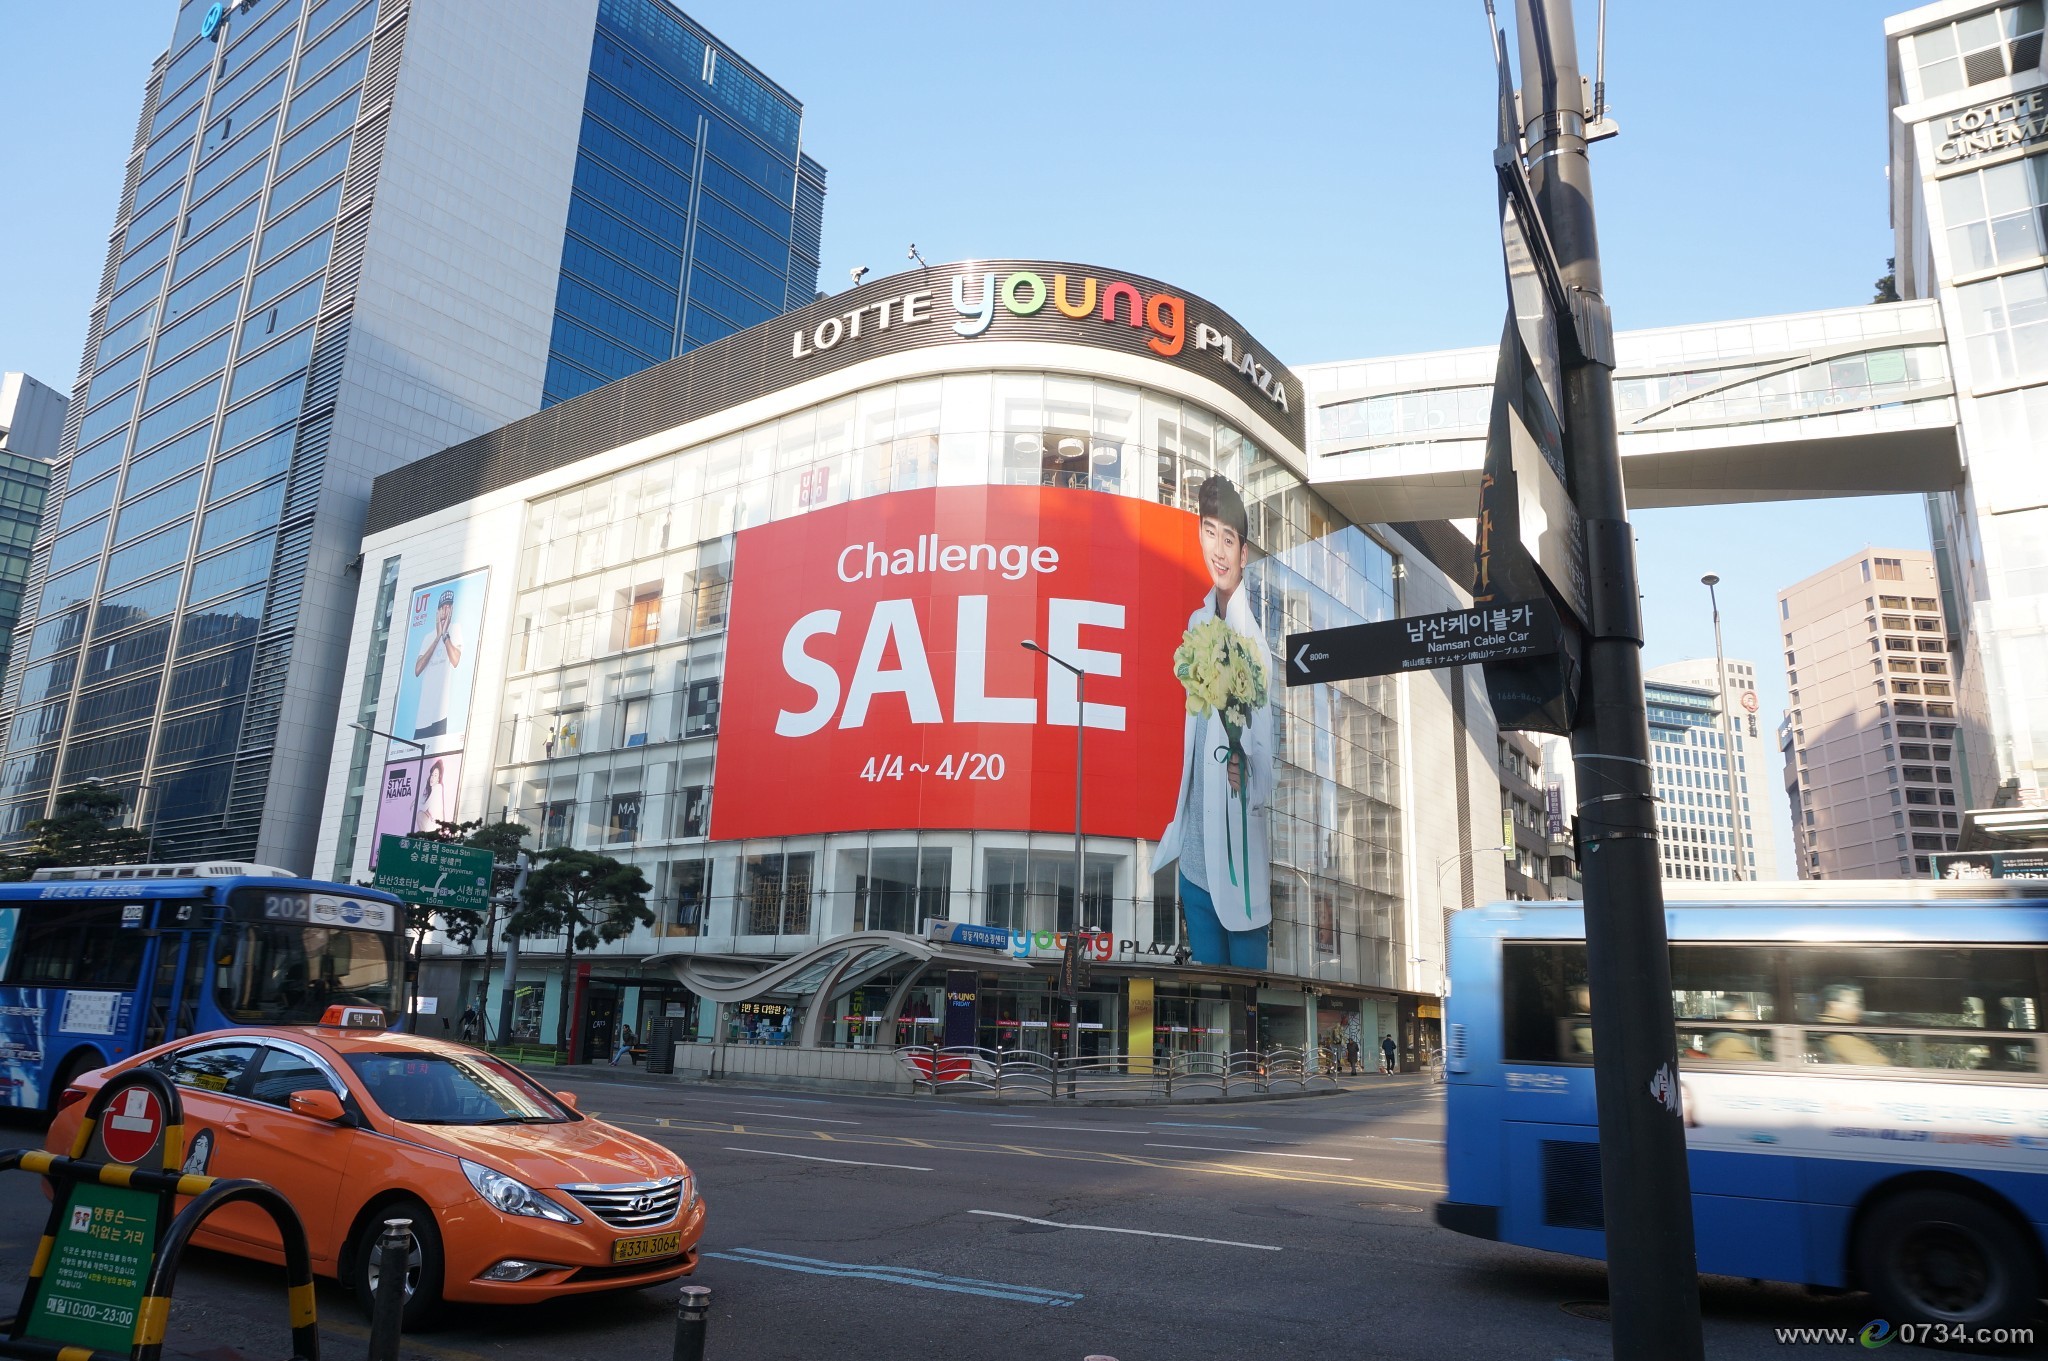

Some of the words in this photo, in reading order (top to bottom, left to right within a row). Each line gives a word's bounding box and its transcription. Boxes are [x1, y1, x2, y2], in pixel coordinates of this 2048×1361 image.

[1945, 91, 2044, 138] LOTTE
[792, 290, 933, 359] LOTTE
[950, 271, 1186, 356] young
[1195, 322, 1289, 414] PLAZA
[837, 533, 1060, 583] Challenge
[416, 593, 431, 614] UT
[1406, 604, 1533, 643] 남산케이블카
[1427, 640, 1470, 653] Namsan
[1473, 634, 1506, 647] Cable
[1508, 631, 1530, 642] Car
[1309, 652, 1330, 661] 800m
[774, 594, 1126, 738] SALE
[859, 754, 904, 782] 4/4
[935, 752, 1005, 782] 4/20
[387, 777, 411, 790] STYLE
[386, 787, 412, 799] NANDA
[412, 841, 440, 853] 서울역
[441, 846, 458, 855] Seoul
[459, 849, 470, 857] Stn
[410, 852, 438, 865] 숭례문
[378, 874, 419, 889] 남산3호터널
[456, 885, 474, 896] 시청
[264, 896, 308, 919] 202
[456, 895, 470, 904] City
[961, 930, 1006, 946] 명동지하쇼핑센터
[1012, 929, 1113, 961] young
[1119, 939, 1187, 957] PLAZA
[947, 991, 976, 1001] YOUNG
[592, 1020, 606, 1029] CATS
[94, 1206, 125, 1225] 명동은
[89, 1223, 121, 1242] 차없는
[123, 1229, 145, 1246] 거리
[650, 1236, 677, 1253] 3064
